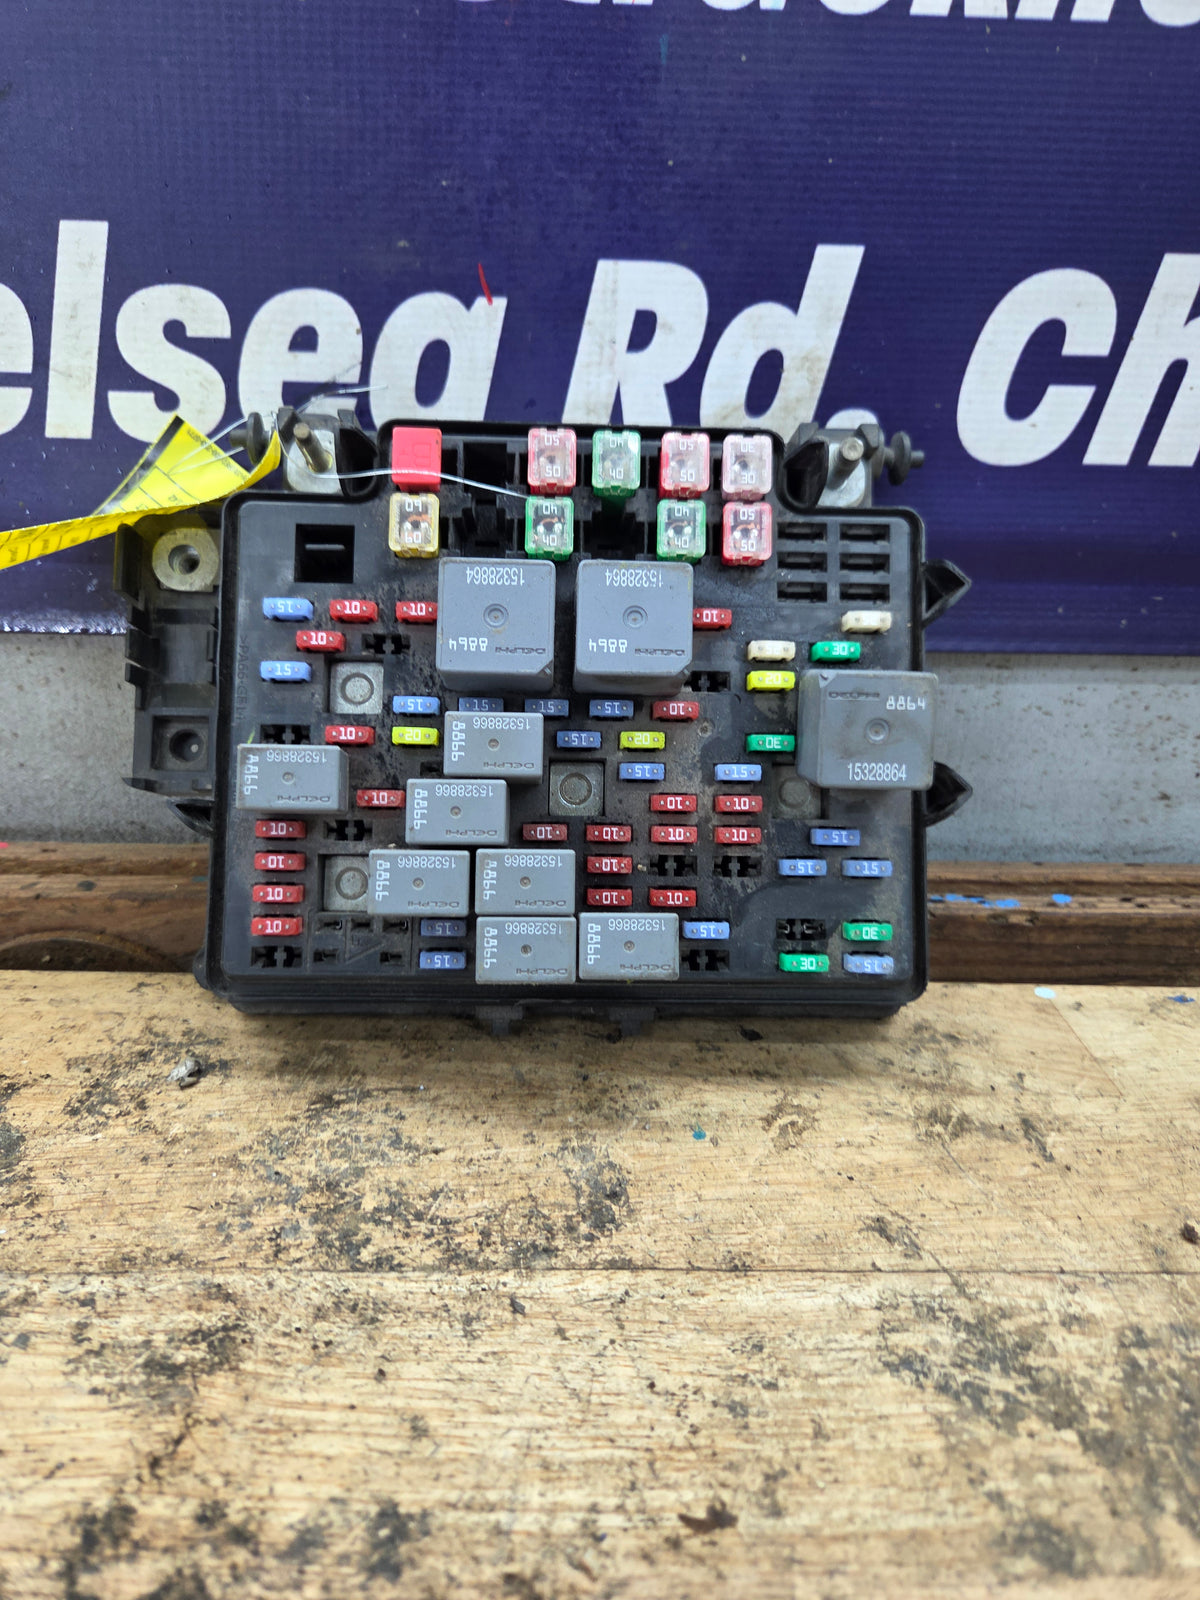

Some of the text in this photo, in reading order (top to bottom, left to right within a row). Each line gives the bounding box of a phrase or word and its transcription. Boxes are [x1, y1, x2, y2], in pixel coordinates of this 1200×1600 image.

[0, 220, 508, 442] lsea
[544, 434, 560, 446] 50
[610, 437, 624, 448] 40
[680, 438, 694, 450] 50
[740, 440, 754, 452] 30
[544, 466, 561, 478] 50
[610, 468, 624, 480] 40
[680, 470, 695, 482] 50
[741, 472, 756, 484] 30
[405, 500, 422, 512] 60
[542, 504, 558, 514] 40
[674, 506, 690, 516] 40
[740, 510, 755, 521] 50
[405, 532, 422, 544] 60
[542, 535, 557, 546] 40
[674, 536, 690, 548] 40
[740, 540, 756, 552] 50
[466, 567, 525, 586] 15328864
[606, 569, 664, 587] 15328864
[278, 602, 294, 613] 15
[344, 602, 360, 614] 10
[409, 603, 426, 615] 10
[703, 610, 718, 622] 10
[310, 632, 326, 645] 10
[449, 638, 488, 652] 8864
[589, 638, 628, 653] 8864
[832, 644, 848, 656] 30
[275, 664, 291, 676] 15
[765, 673, 782, 684] 20
[408, 699, 423, 710] 15
[472, 700, 489, 711] 15
[540, 701, 555, 712] 15
[604, 702, 620, 714] 15
[670, 703, 685, 715] 10
[886, 696, 926, 710] 8864
[472, 716, 531, 730] 15328866
[339, 728, 355, 740] 10
[405, 729, 422, 741] 20
[571, 733, 587, 745] 15
[634, 733, 650, 745] 20
[766, 737, 782, 749] 30
[266, 750, 328, 762] 15328866
[634, 766, 650, 777] 15
[732, 766, 748, 778] 15
[848, 762, 906, 782] 15328864
[436, 784, 494, 797] 15328866
[372, 792, 388, 804] 10
[667, 797, 683, 810] 10
[734, 798, 749, 810] 10
[270, 823, 286, 835] 10
[536, 826, 552, 838] 10
[603, 827, 618, 840] 10
[668, 828, 684, 840] 10
[732, 829, 748, 841] 10
[832, 830, 848, 843] 15
[268, 855, 284, 868] 10
[397, 856, 456, 868] 15328866
[504, 854, 563, 868] 15328866
[602, 858, 618, 872] 10
[797, 862, 814, 874] 15
[862, 862, 879, 874] 15
[266, 888, 283, 900] 10
[602, 892, 618, 904] 10
[666, 892, 683, 905] 10
[265, 920, 282, 932] 10
[435, 922, 451, 934] 15
[504, 922, 562, 935] 15328866
[608, 918, 666, 932] 15328866
[700, 925, 716, 937] 15
[862, 927, 879, 940] 30
[434, 954, 450, 967] 15
[800, 958, 816, 970] 30
[864, 960, 880, 972] 15
